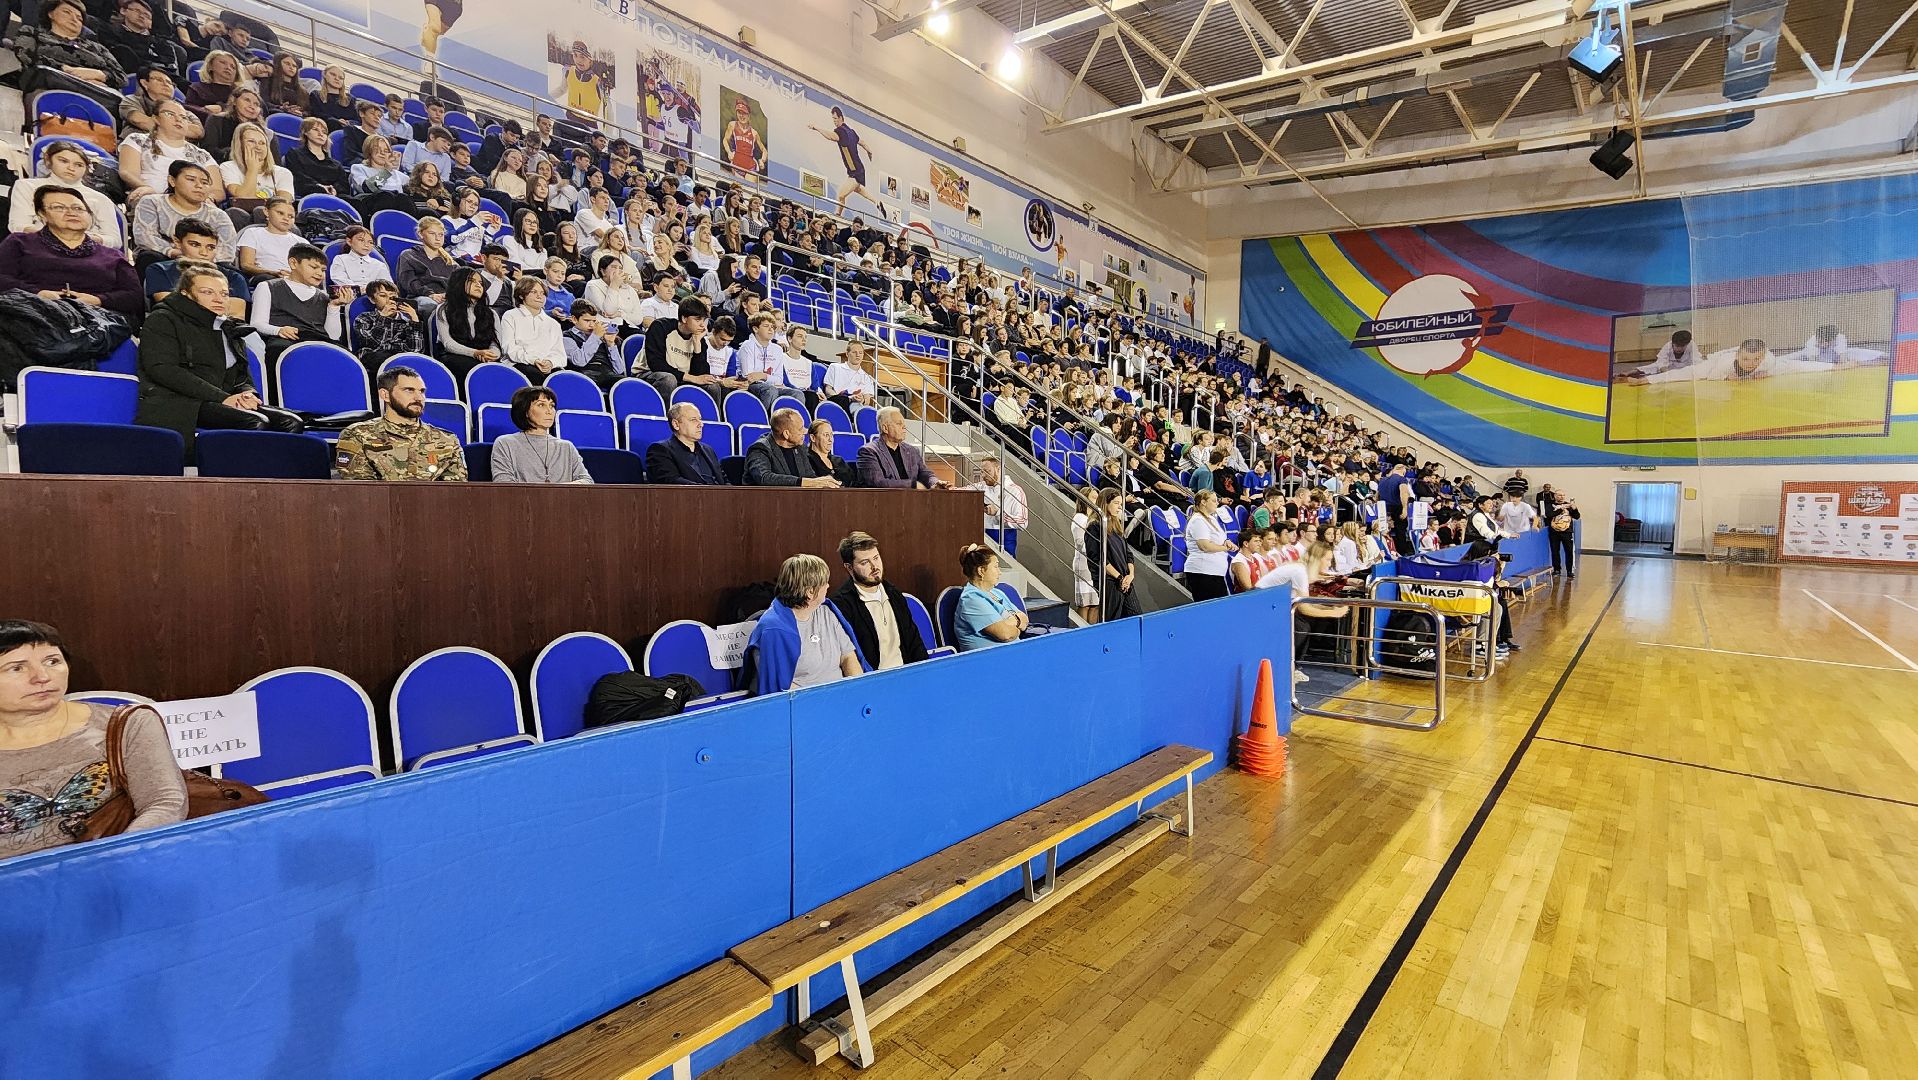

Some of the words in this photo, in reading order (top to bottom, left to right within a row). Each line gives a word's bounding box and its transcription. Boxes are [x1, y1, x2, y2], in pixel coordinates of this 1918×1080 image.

[634, 12, 808, 106] ПОБЕДИТЕЛЕЙ
[943, 226, 960, 240] ТВОЯ
[991, 243, 1008, 258] ТВОЙ
[1371, 311, 1473, 332] ЮБИЛЕЙНЫЙ
[1389, 336, 1422, 344] ДВОРЕЦ
[1422, 333, 1456, 341] СПОРТА
[1410, 583, 1465, 598] MIKASA
[715, 631, 747, 640] МЕСТА
[714, 653, 743, 662] ЗАНИМ
[180, 728, 207, 740] НЕ
[175, 739, 246, 758] ИМАТЬ
